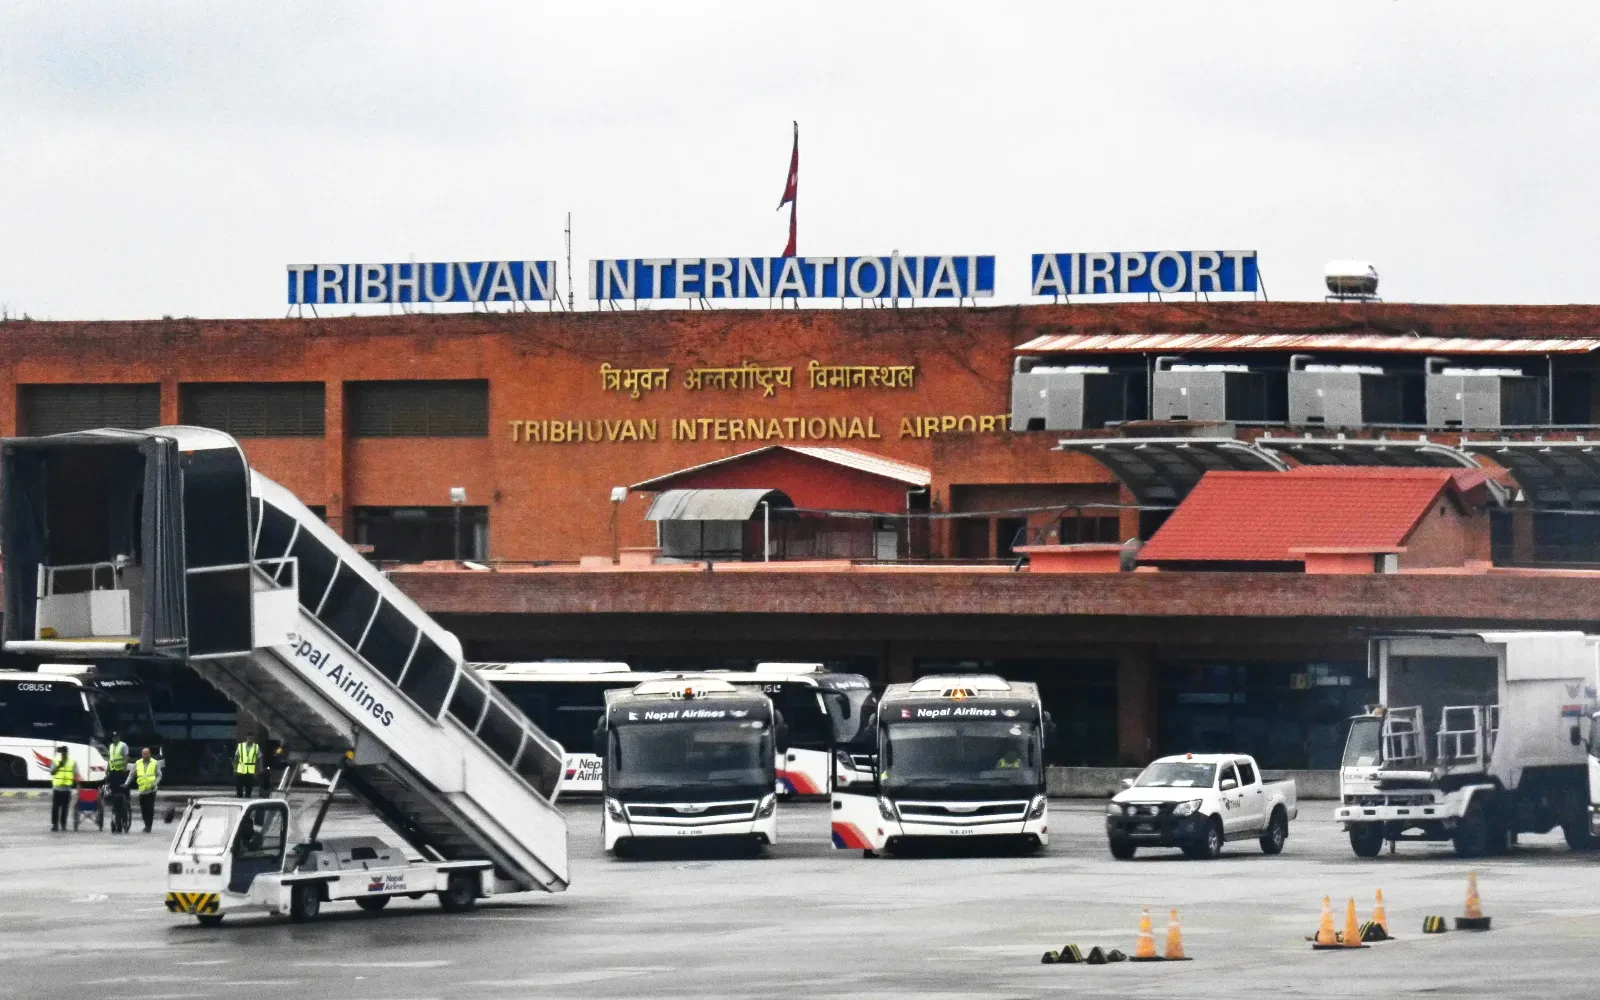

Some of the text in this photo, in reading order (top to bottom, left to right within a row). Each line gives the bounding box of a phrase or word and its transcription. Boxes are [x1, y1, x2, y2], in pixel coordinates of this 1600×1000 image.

[287, 250, 1257, 304] TRIBHUVAN INTERNATIONAL AIRPORT
[600, 363, 670, 398] त्रिभुवन
[808, 360, 915, 389] विमानस्थल
[508, 414, 1014, 442] TRIBHUVAN INTERNATIONAL AIRPORT
[18, 682, 45, 692] COBUS
[326, 663, 394, 727] Airlines
[645, 709, 726, 721] Nepal Airlines
[917, 707, 997, 718] Nepal Airlines
[579, 758, 602, 773] Nep
